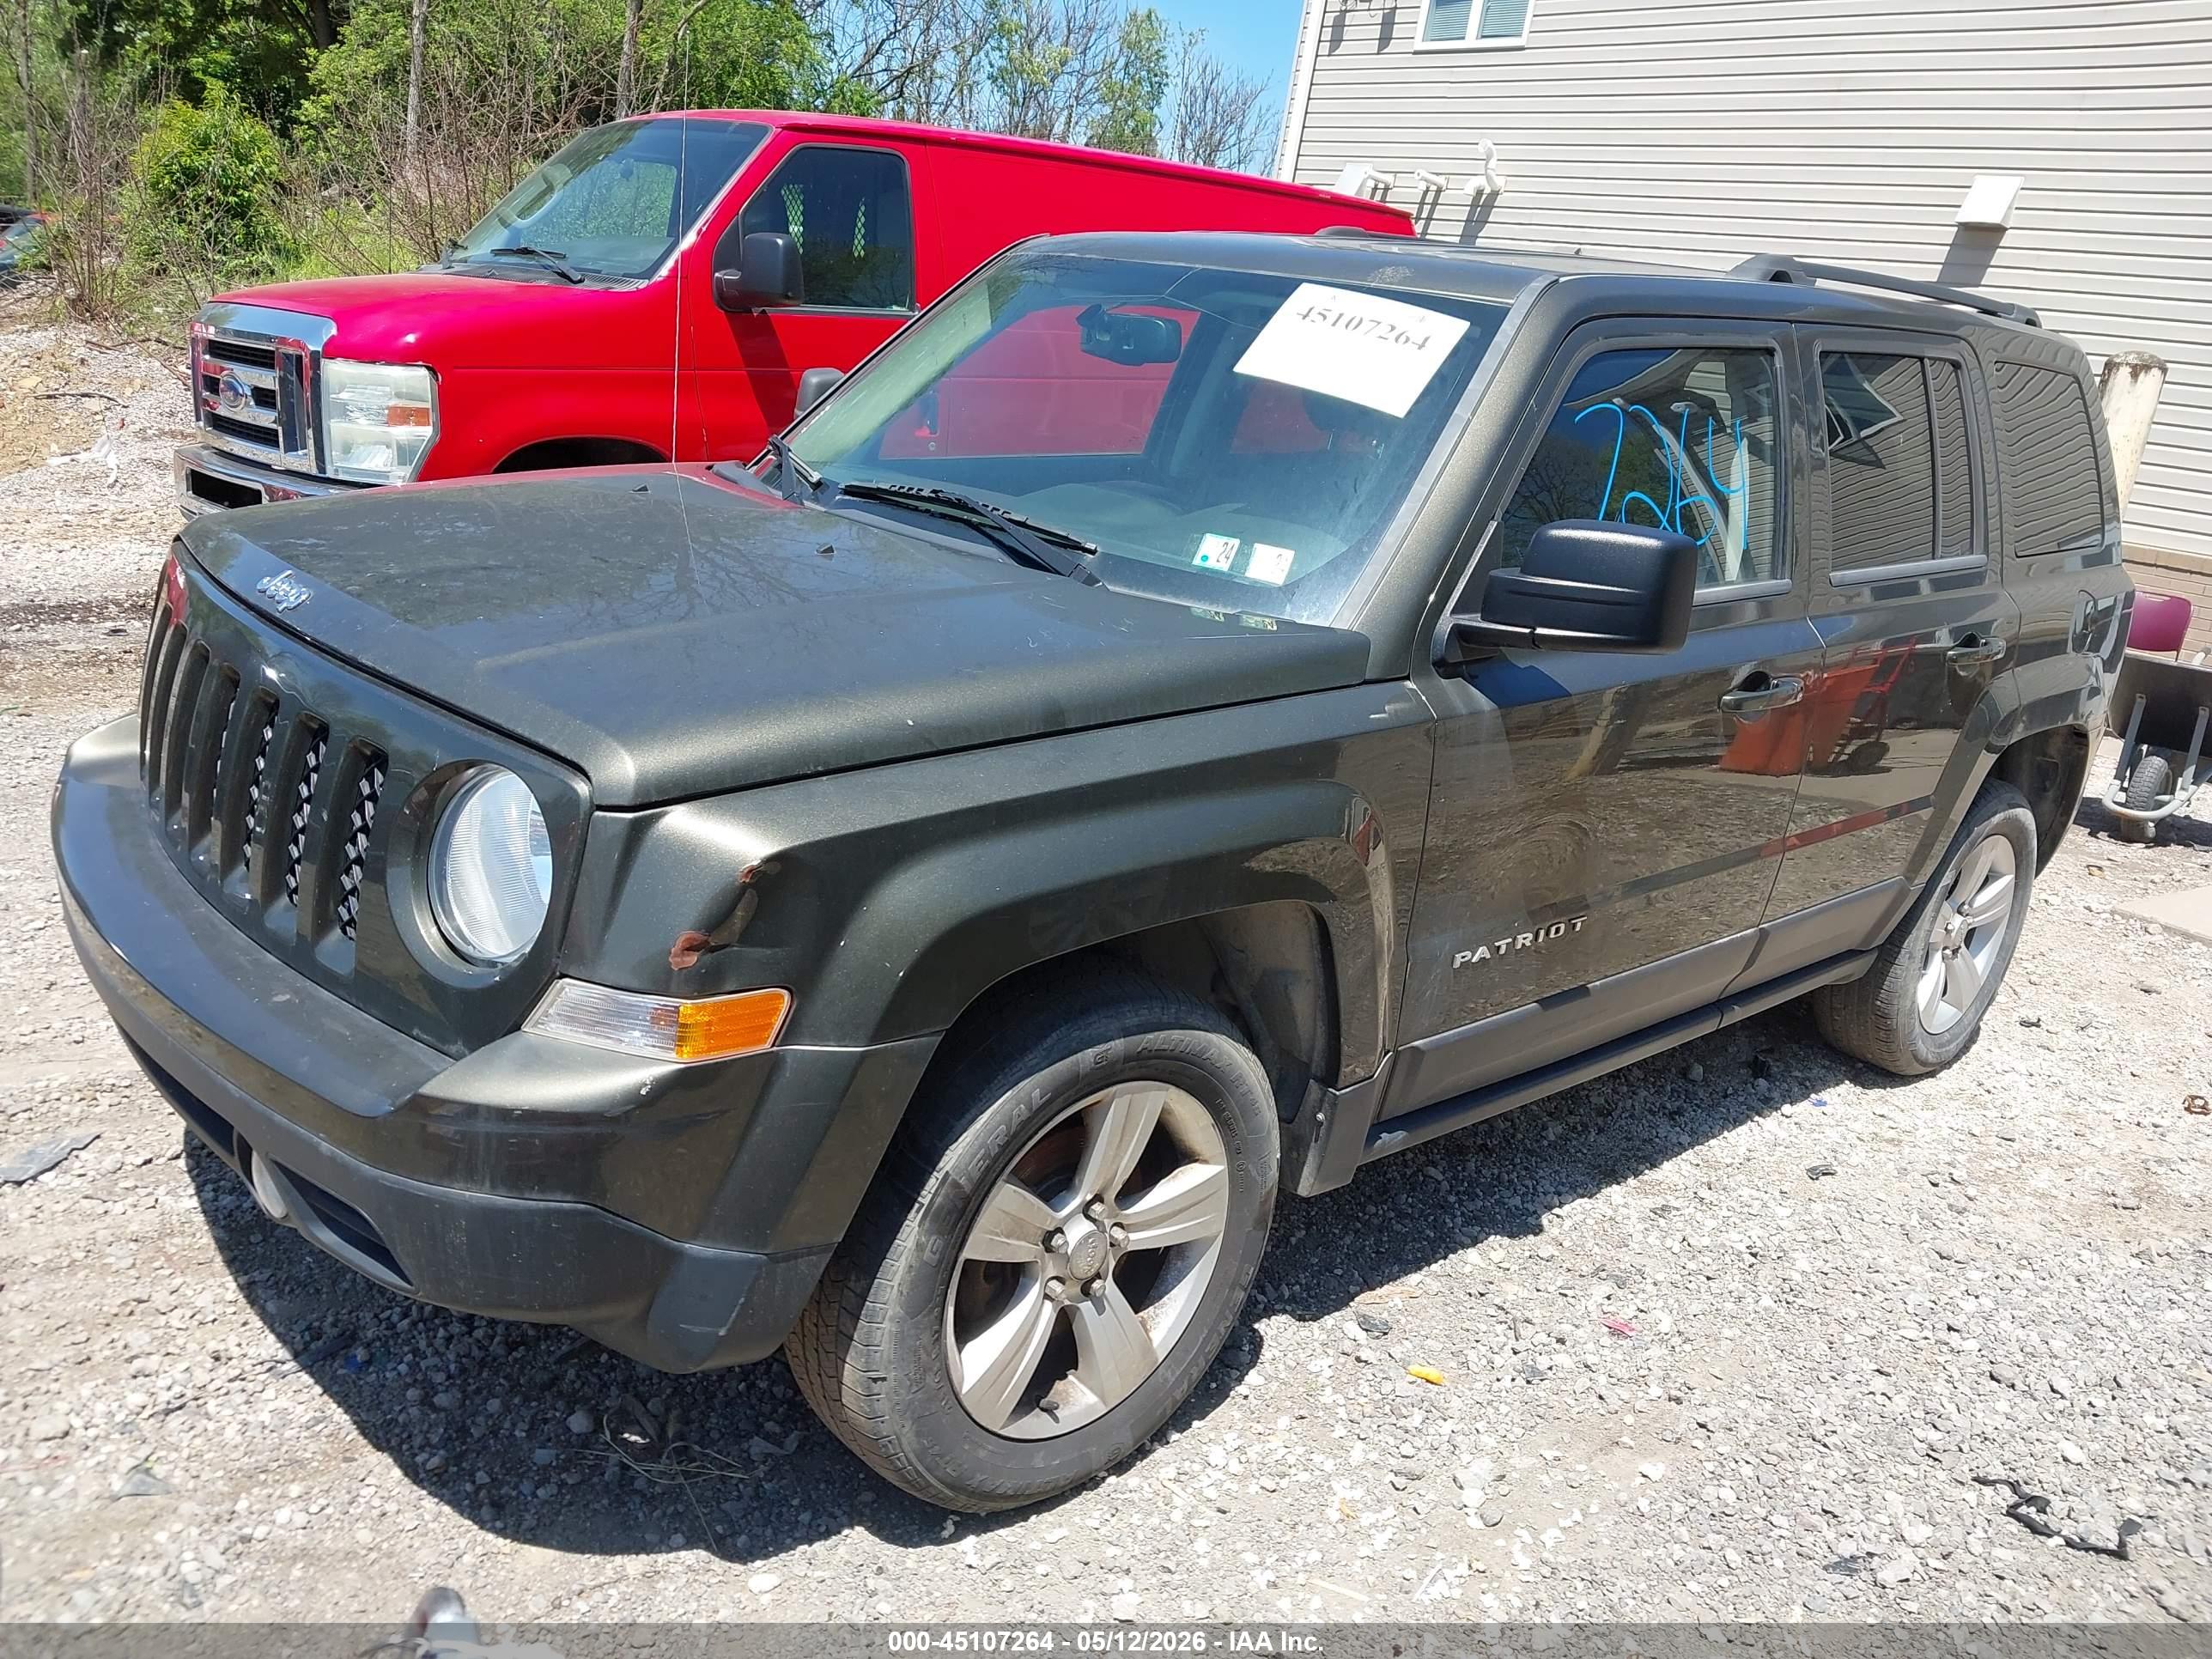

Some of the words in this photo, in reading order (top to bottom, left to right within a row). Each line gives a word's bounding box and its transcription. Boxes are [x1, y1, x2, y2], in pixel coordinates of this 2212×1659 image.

[1296, 305, 1432, 351] 45107264
[256, 569, 311, 613] Jeep
[1451, 914, 1588, 969] PATRIOT
[1135, 1034, 1233, 1074] ALTIMAX
